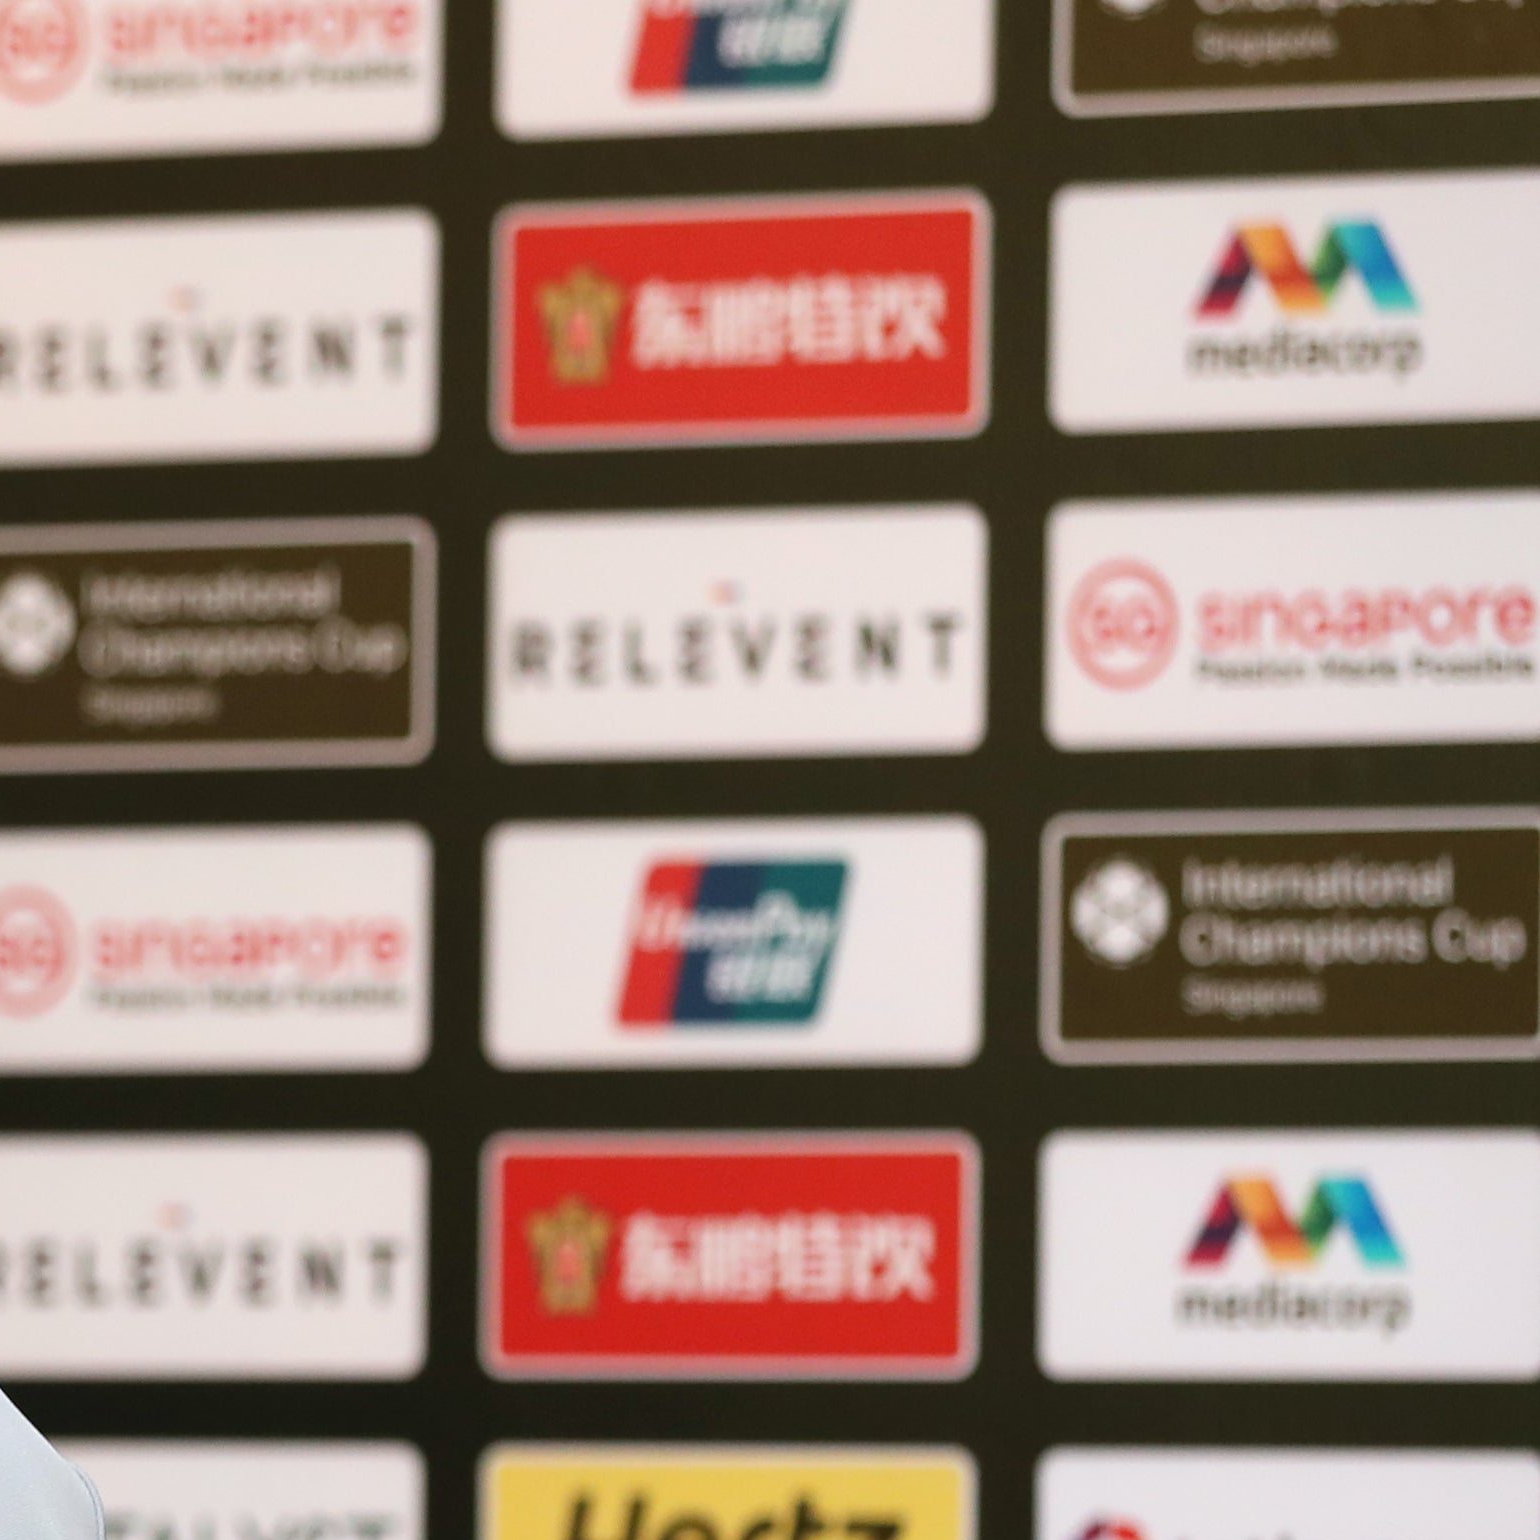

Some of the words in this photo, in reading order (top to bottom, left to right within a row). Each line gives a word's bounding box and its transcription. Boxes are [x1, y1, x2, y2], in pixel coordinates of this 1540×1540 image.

[1189, 325, 1427, 380] mediacorp
[513, 610, 961, 684] RELEVENT
[1183, 858, 1453, 906] International
[1181, 914, 1427, 968] Champions
[1433, 908, 1527, 968] Cup
[1179, 1280, 1413, 1334] mediacorp
